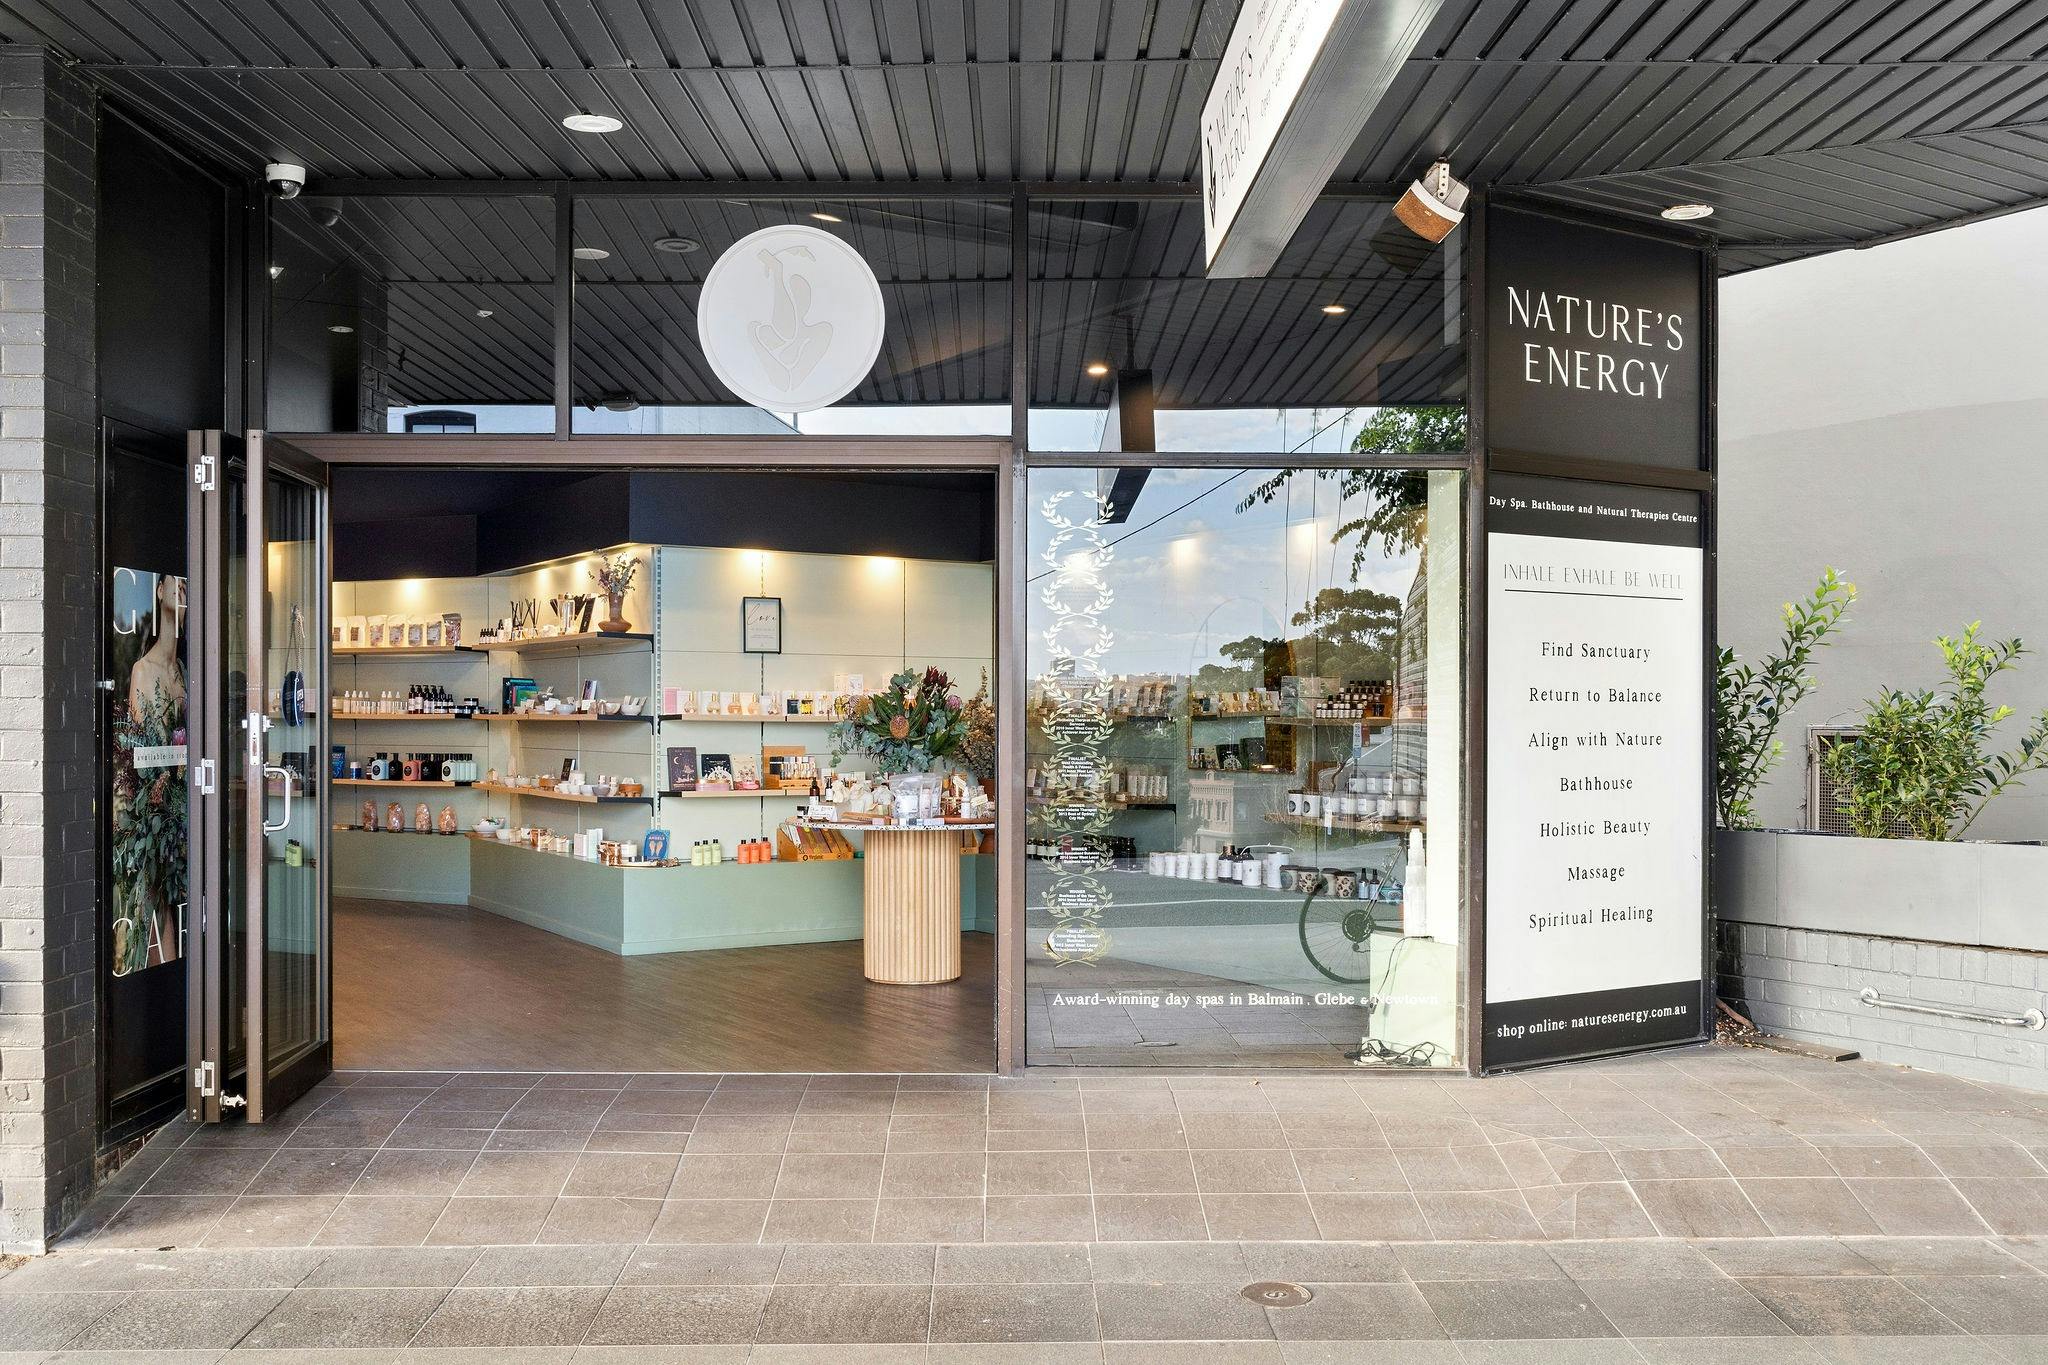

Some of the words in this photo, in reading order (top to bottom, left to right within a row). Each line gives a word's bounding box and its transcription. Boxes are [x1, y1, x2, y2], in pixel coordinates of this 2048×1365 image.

[1507, 286, 1683, 351] NATURE'S
[1524, 342, 1669, 400] ENERGY
[1489, 496, 1506, 508] Day
[1531, 499, 1575, 513] Bathhouse
[1578, 504, 1593, 515] and
[1596, 505, 1628, 517] Natural
[1631, 508, 1669, 521] Therapies
[1672, 512, 1698, 523] Centre
[1503, 563, 1556, 582] INHALE
[1563, 566, 1617, 586] EXHALE
[1624, 571, 1641, 587] BE
[1648, 572, 1684, 590] WELL
[1541, 641, 1573, 658] Find
[1581, 643, 1651, 663] Sanctuary
[1529, 687, 1579, 702] Return
[1587, 689, 1601, 703] to
[1608, 688, 1662, 703] Balance
[1528, 732, 1568, 751] Align
[1576, 732, 1607, 746] with
[1615, 732, 1662, 747] Nature
[137, 752, 166, 761] available
[1560, 776, 1633, 792] Bathhouse
[1540, 821, 1595, 838] Holistic
[1603, 819, 1651, 836] Beauty
[1567, 866, 1625, 882] Massage
[1529, 909, 1593, 932] Spiritual
[1601, 906, 1654, 923] Healing
[1052, 991, 1160, 1008] Award-winning
[1164, 991, 1191, 1008] day
[1195, 992, 1224, 1008] spas
[1229, 992, 1243, 1006] in
[1314, 992, 1355, 1006] Glebe
[1360, 995, 1370, 1005] &
[1373, 992, 1440, 1006] Newtown
[1497, 1023, 1525, 1039] shop
[1529, 1019, 1568, 1034] online:
[1571, 1003, 1687, 1028] naturesenergy.com.au
